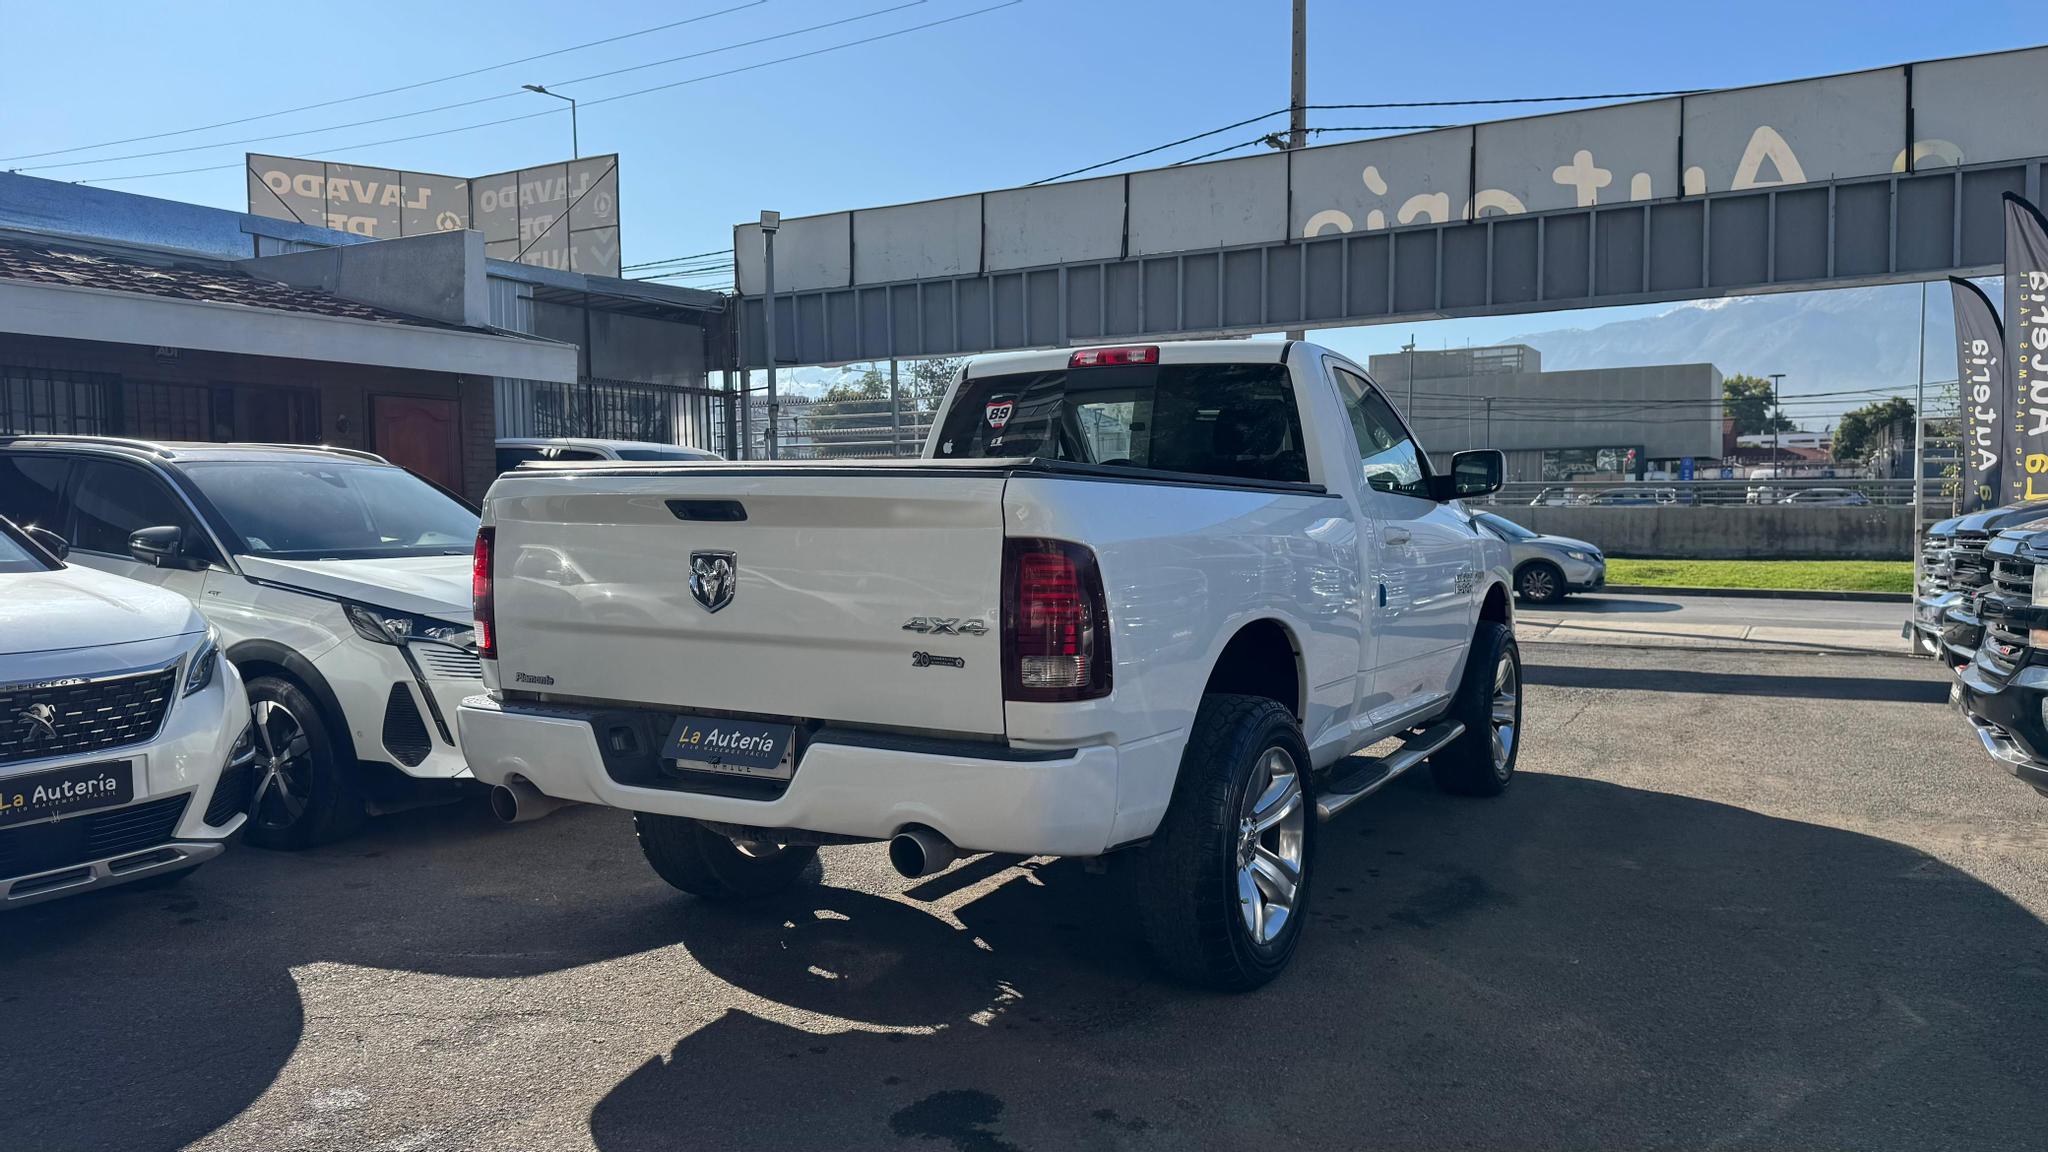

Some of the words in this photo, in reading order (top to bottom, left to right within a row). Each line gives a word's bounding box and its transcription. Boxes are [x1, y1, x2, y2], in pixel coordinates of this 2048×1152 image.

[989, 407, 1010, 420] 89
[912, 651, 930, 667] 20
[679, 726, 701, 744] La
[704, 728, 774, 752] Autería
[0, 793, 24, 810] La
[32, 773, 117, 803] Autería
